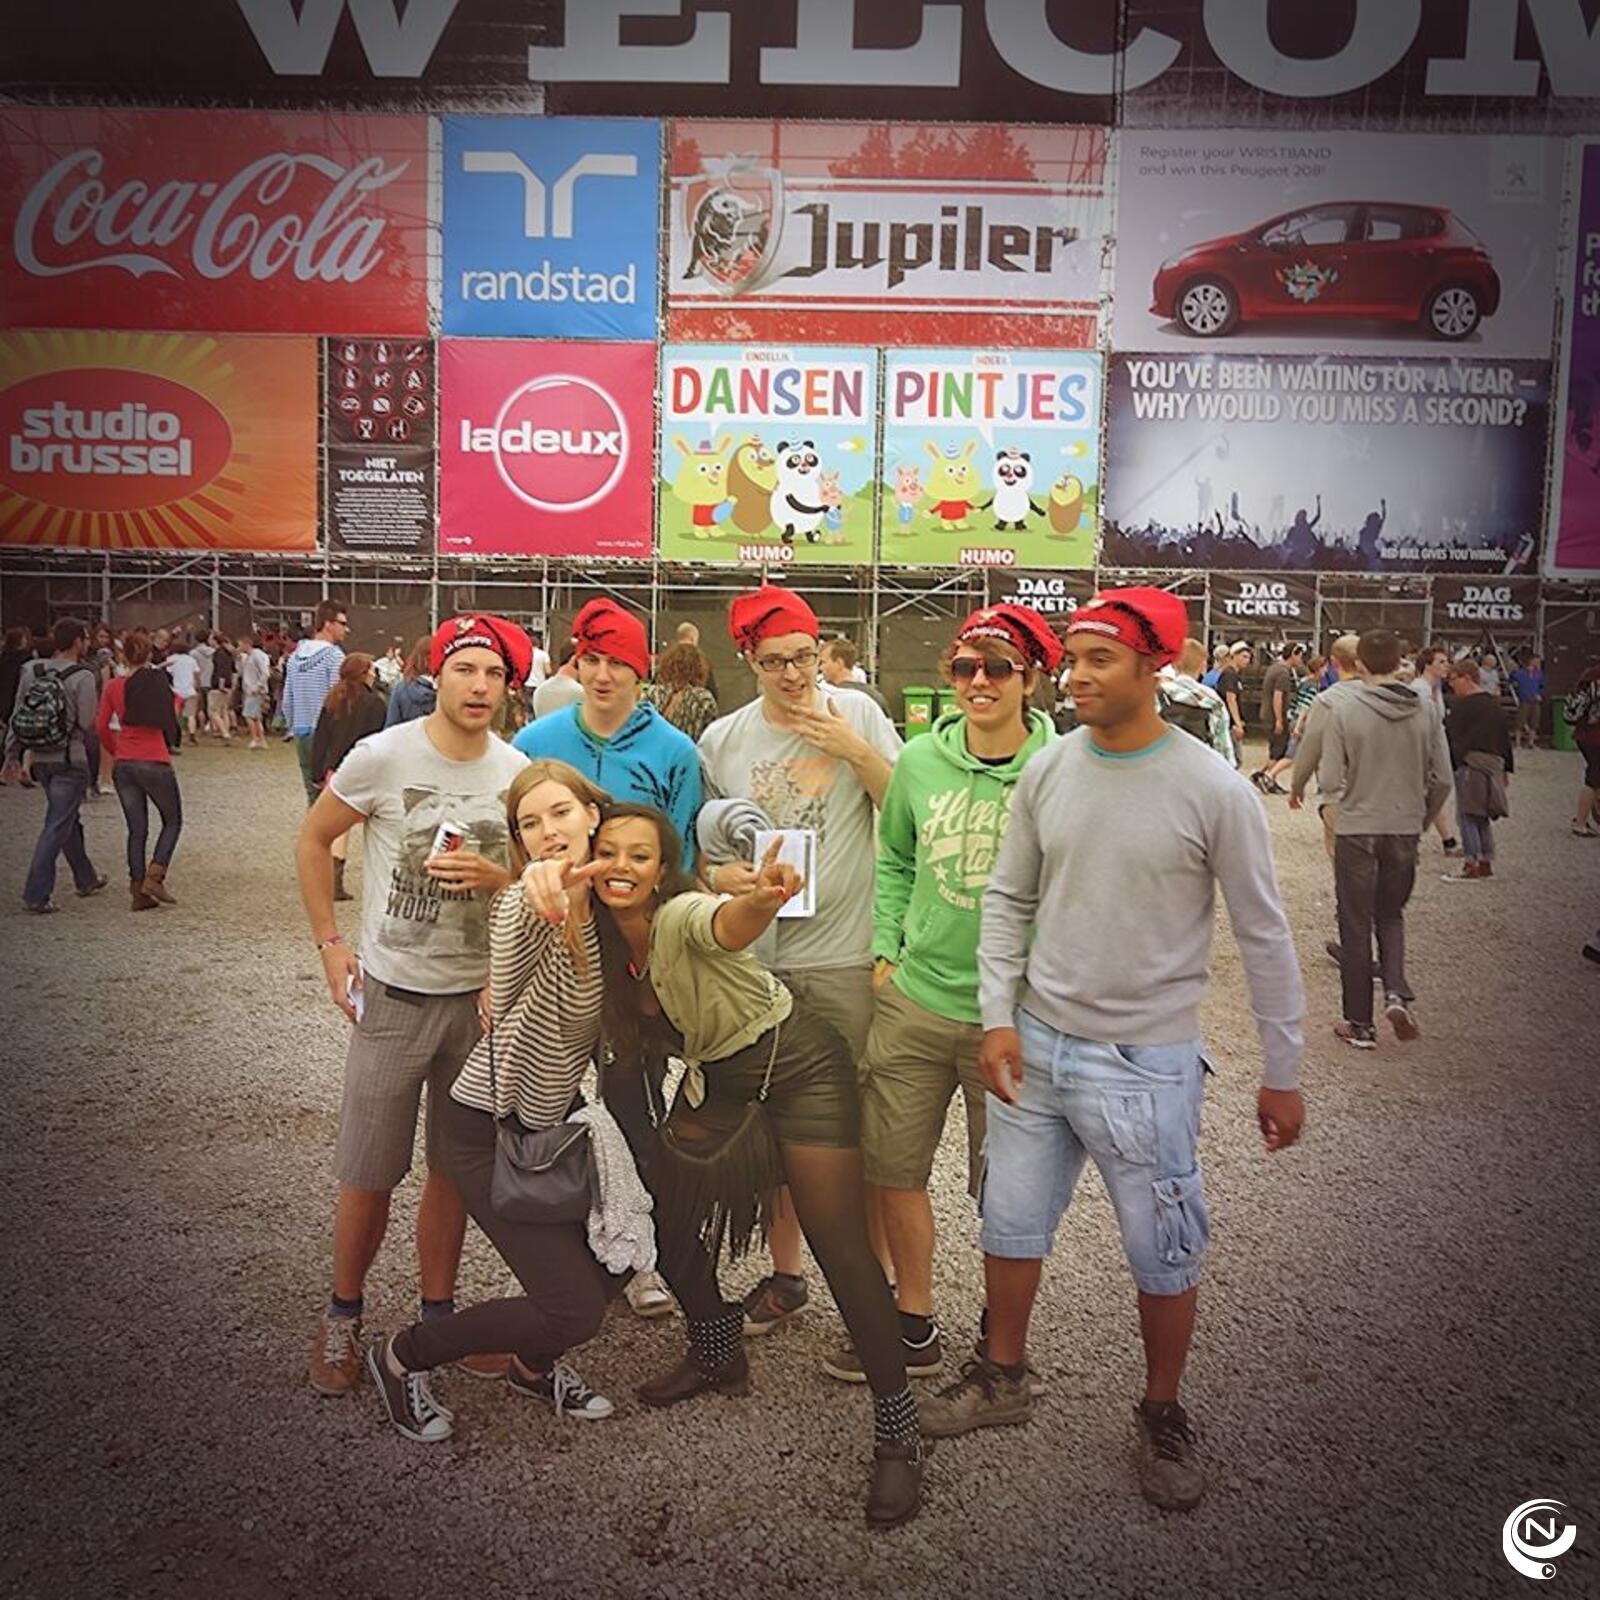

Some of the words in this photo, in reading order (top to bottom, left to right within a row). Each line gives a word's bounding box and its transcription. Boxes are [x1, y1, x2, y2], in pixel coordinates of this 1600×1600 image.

[1139, 146, 1198, 160] Register
[1202, 149, 1235, 161] your
[1239, 147, 1332, 160] WRISTBAND
[1138, 164, 1166, 176] and
[1171, 165, 1196, 176] win
[1200, 165, 1226, 177] this
[1230, 165, 1289, 179] Peugeot
[13, 149, 412, 283] Coca-Cola
[779, 202, 1080, 290] Jupiler
[461, 259, 637, 307] randstad
[1127, 361, 1212, 389] YOU'VE
[1218, 363, 1272, 390] BEEN
[1278, 364, 1376, 392] WAITING
[1380, 365, 1427, 393] FOR
[1433, 367, 1451, 393] A
[1455, 368, 1514, 395] YEAR
[672, 367, 863, 418] DANSEN
[896, 371, 1087, 422] PINTJES
[1133, 391, 1190, 419] WHY
[1196, 394, 1280, 421] WOULD
[1287, 395, 1336, 422] YOU
[1342, 397, 1396, 423] MISS
[1401, 398, 1419, 424] A
[1425, 398, 1528, 427] SECOND?
[23, 401, 180, 442] studio
[10, 438, 192, 477] brussel
[364, 457, 397, 470] NIET
[339, 470, 425, 483] TOEGELATEN
[739, 546, 793, 560] HUMO
[960, 549, 1014, 564] HUMO
[1016, 578, 1065, 595] DAG
[1239, 582, 1287, 599] DAG
[1462, 586, 1512, 602] DAG
[1224, 599, 1300, 616] TICKETS
[1446, 603, 1524, 620] TICKETS
